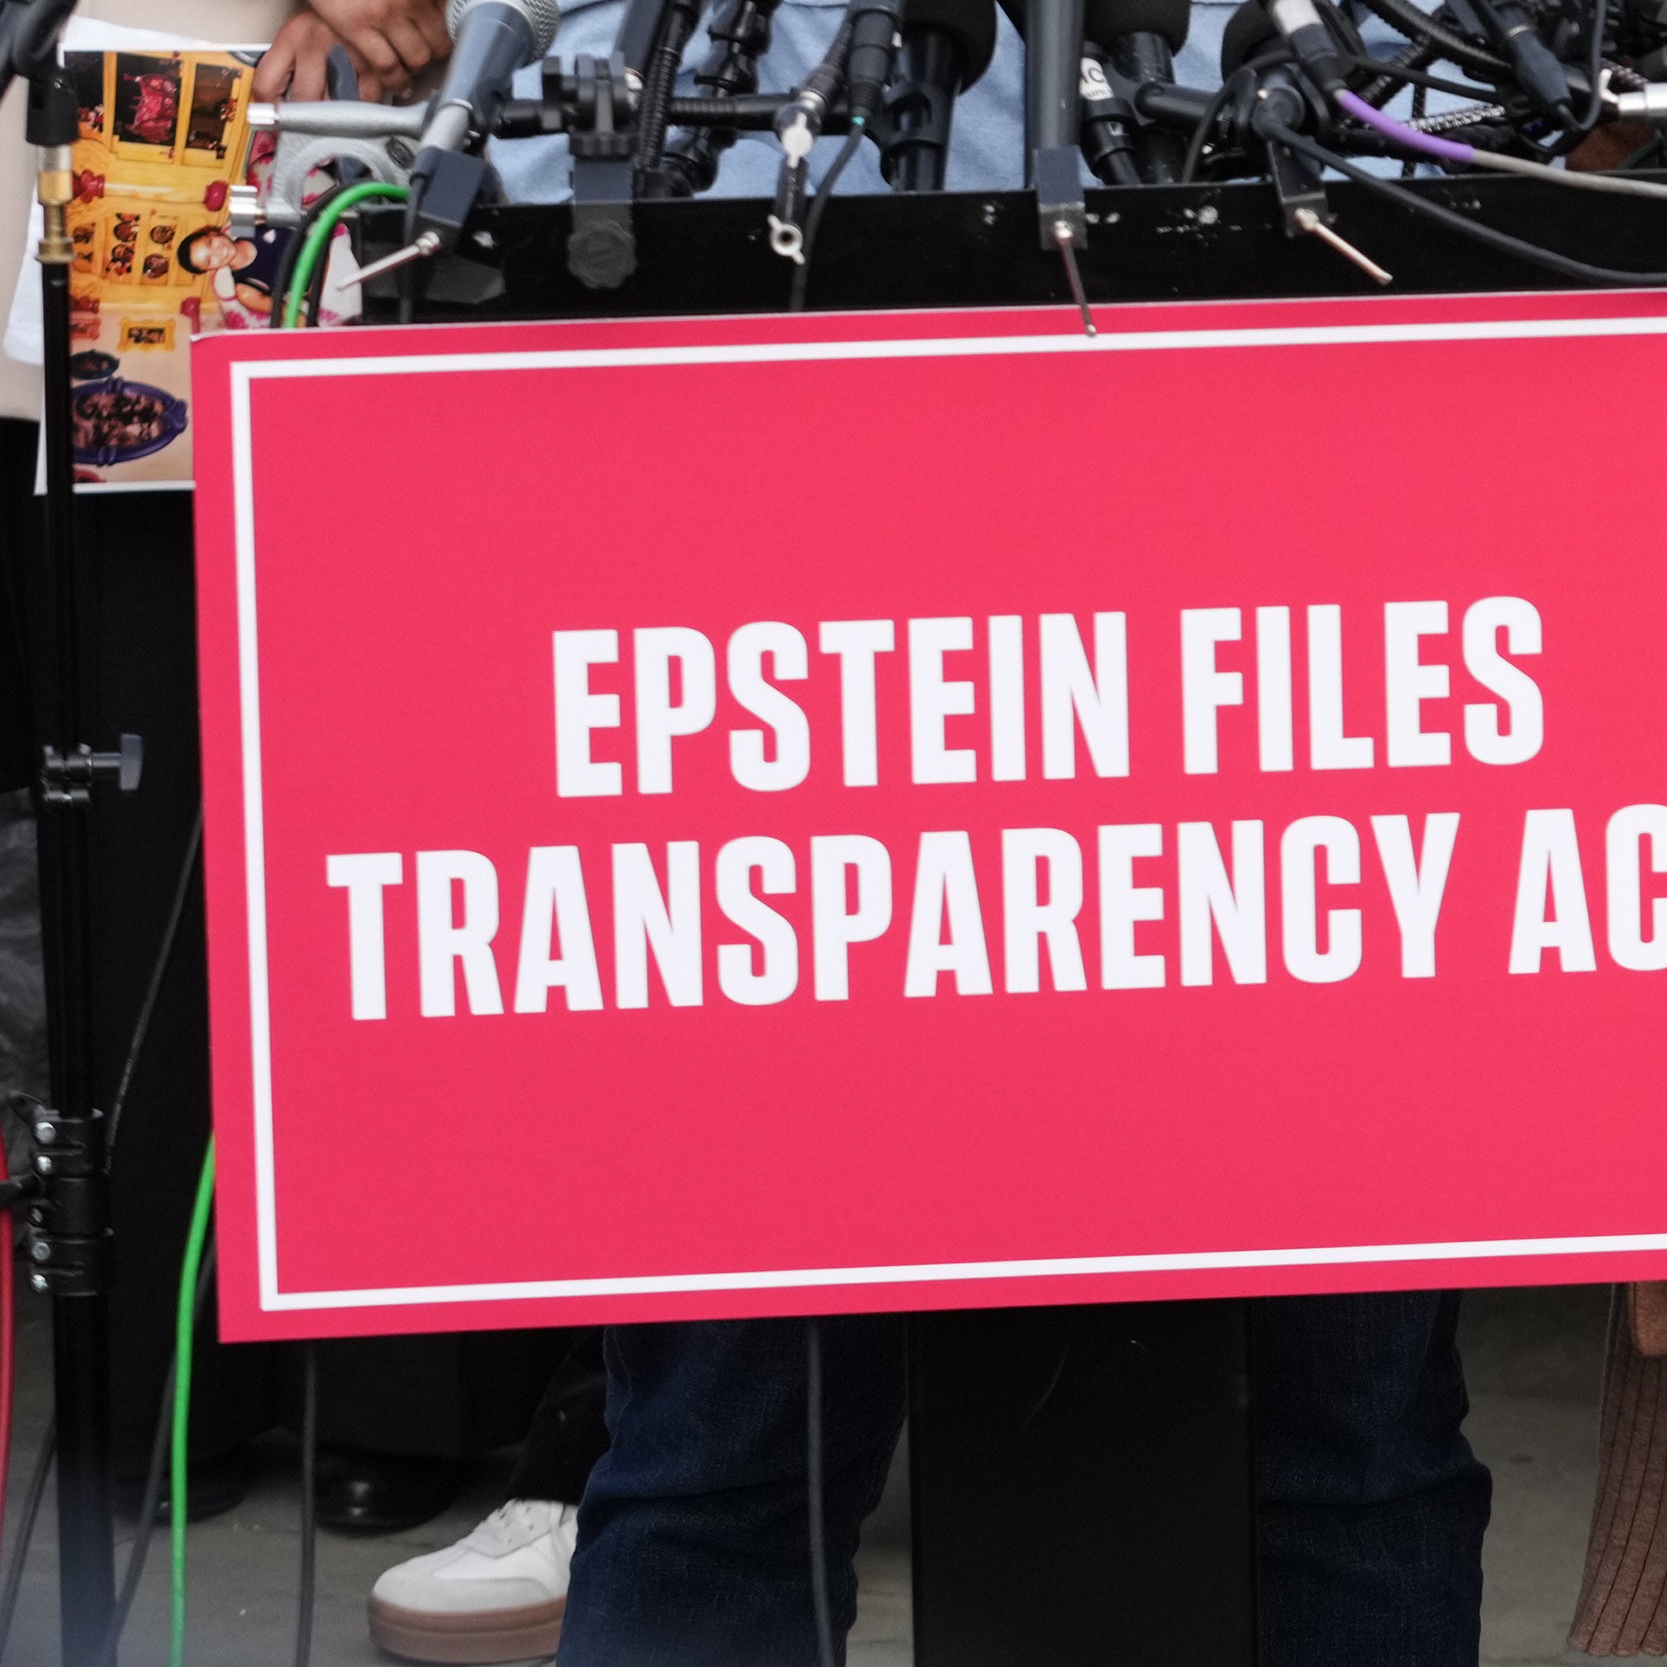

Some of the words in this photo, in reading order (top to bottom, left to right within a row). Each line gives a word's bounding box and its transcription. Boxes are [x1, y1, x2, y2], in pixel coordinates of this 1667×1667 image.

[553, 611, 1130, 798] EPSTEIN
[1181, 595, 1544, 775] FILES
[326, 812, 1461, 1021] TRANSPARENCY
